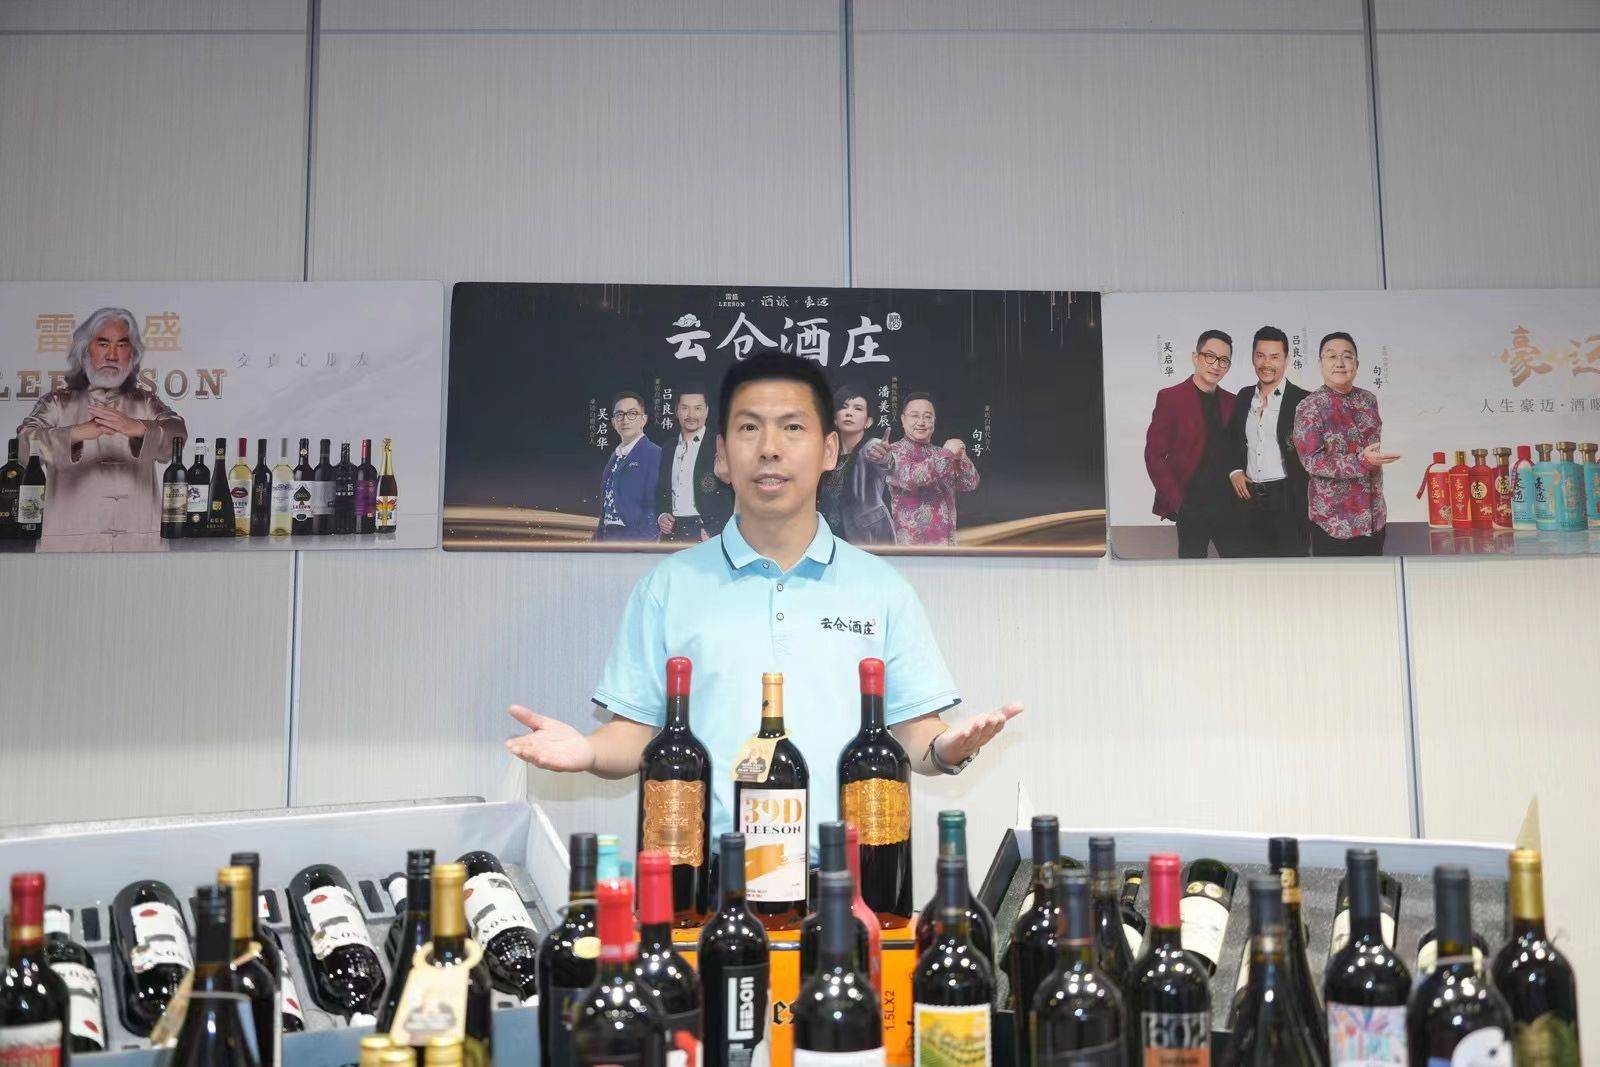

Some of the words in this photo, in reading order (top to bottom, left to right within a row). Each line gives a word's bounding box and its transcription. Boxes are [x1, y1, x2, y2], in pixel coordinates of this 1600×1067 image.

[665, 312, 891, 367] 云仓酒庄
[661, 388, 674, 431] 吕良伟
[878, 384, 891, 428] 潘美辰
[596, 407, 609, 451] 吴启华
[971, 429, 984, 457] 句号
[820, 616, 875, 635] 云仓酒庄
[744, 798, 803, 824] 39D
[745, 825, 801, 835] LEESON
[884, 989, 895, 1031] 1.5LX2
